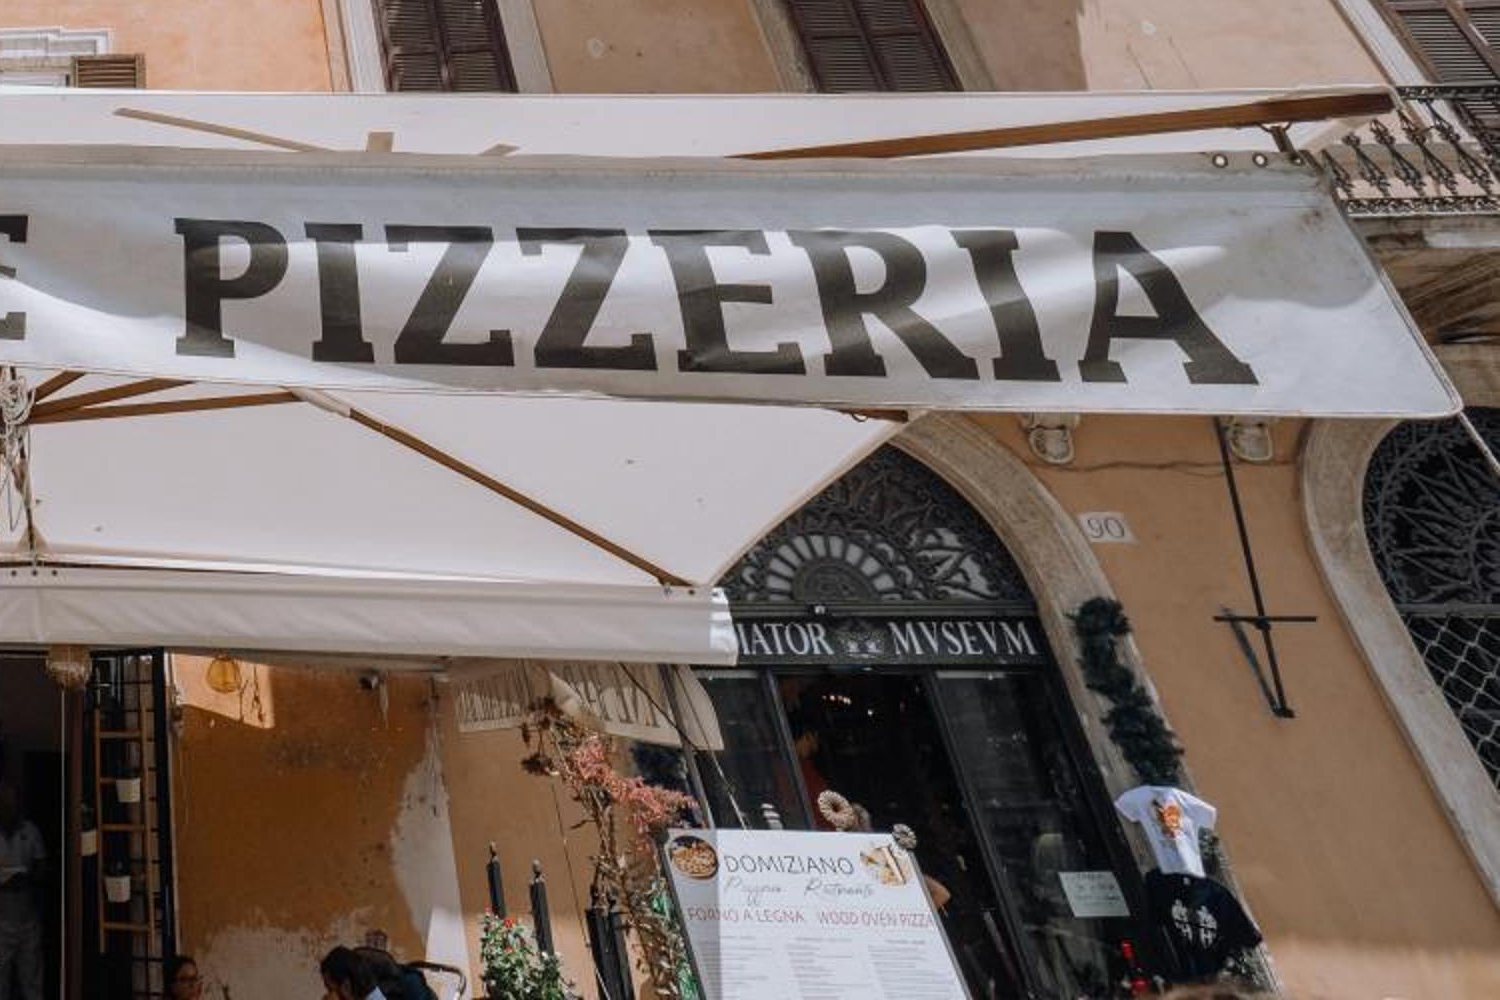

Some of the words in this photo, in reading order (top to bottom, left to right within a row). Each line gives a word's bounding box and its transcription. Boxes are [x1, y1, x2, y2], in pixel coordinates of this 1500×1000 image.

[174, 217, 1259, 385] PIZZERIA
[1086, 516, 1125, 539] 90
[887, 620, 1038, 656] MVSEVM
[723, 855, 855, 875] DOMIZIANO
[756, 908, 805, 923] LEGNA
[819, 910, 859, 926] WOOD
